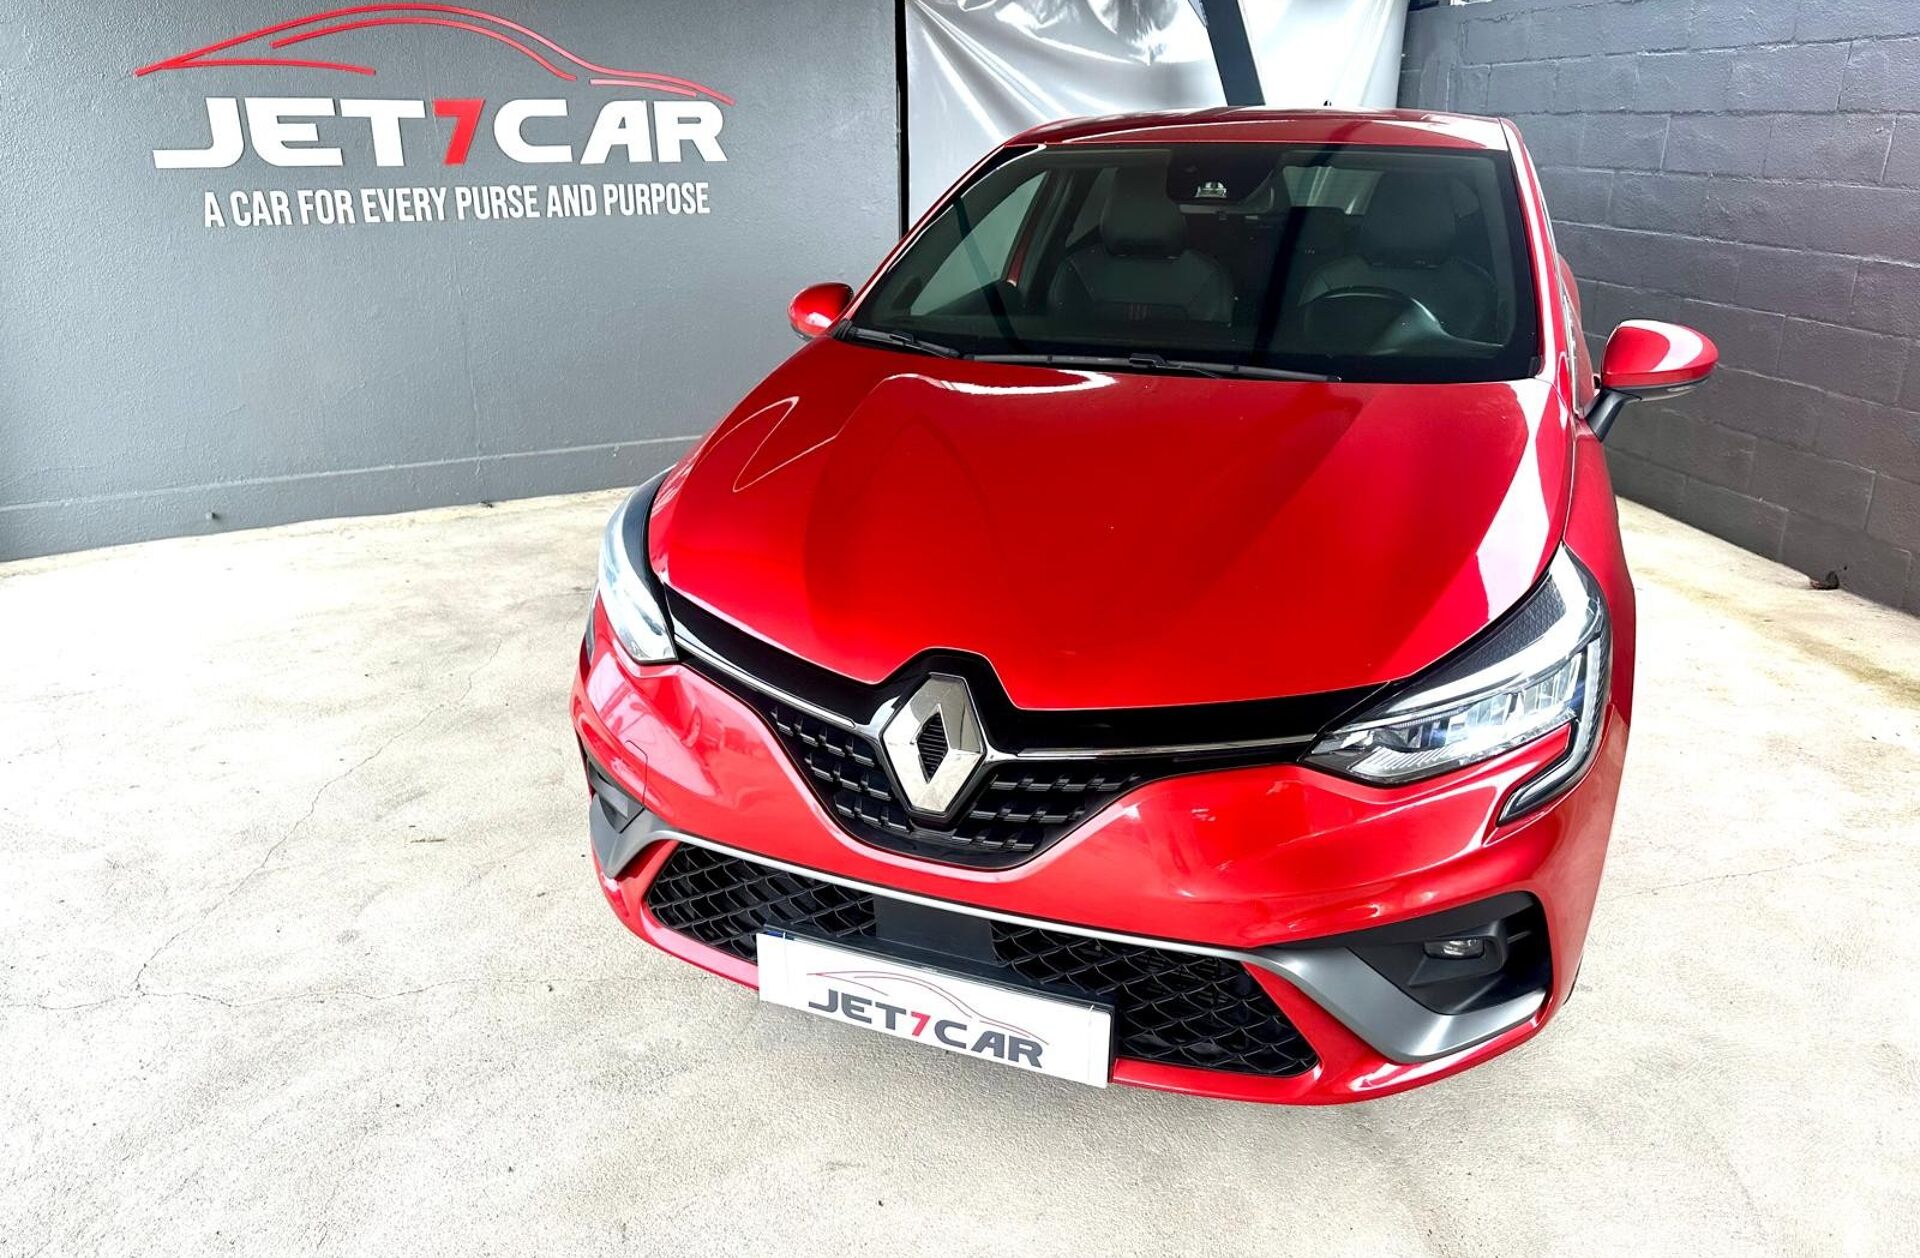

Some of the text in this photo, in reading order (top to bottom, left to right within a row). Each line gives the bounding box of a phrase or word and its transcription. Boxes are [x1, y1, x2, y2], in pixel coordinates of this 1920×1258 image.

[203, 181, 711, 228] A CAR FOR EVERY PURSE AND PURPOSE
